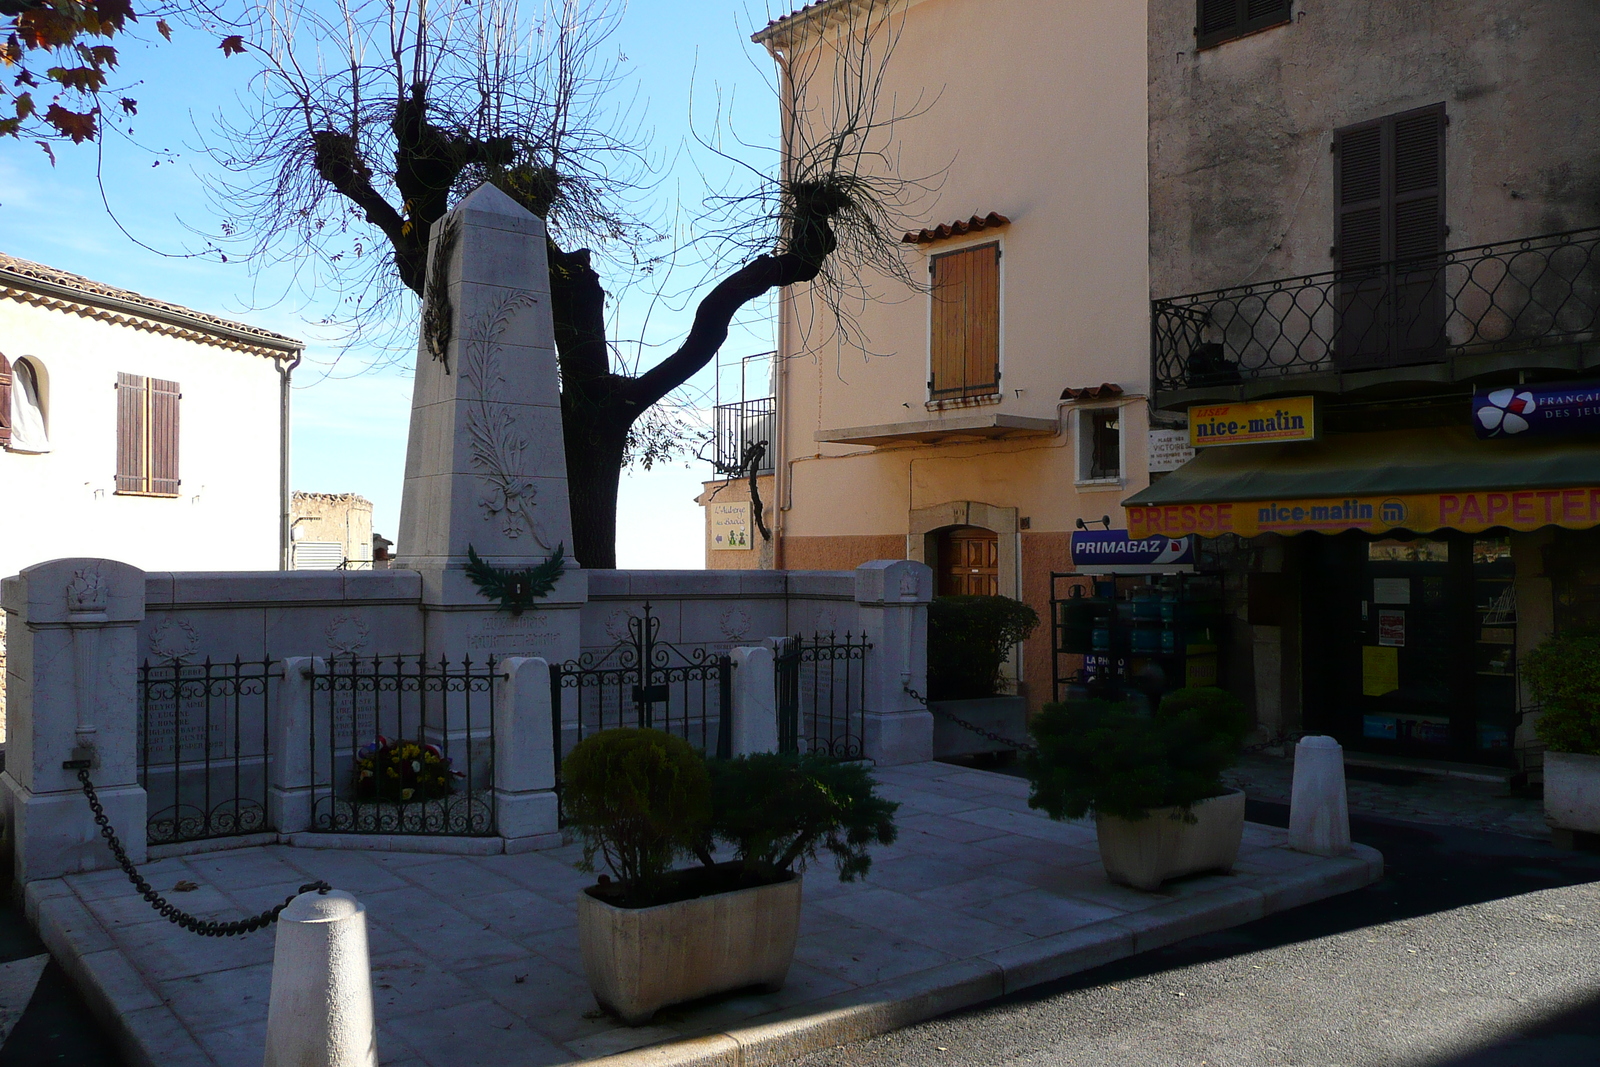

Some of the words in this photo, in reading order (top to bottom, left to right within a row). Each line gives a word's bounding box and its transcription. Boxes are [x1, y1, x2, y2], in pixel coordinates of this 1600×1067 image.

[1196, 407, 1230, 418] LISEZ
[1545, 410, 1570, 420] DES
[1196, 409, 1305, 437] nice-matin
[1130, 504, 1233, 533] PRESSE
[1258, 500, 1373, 522] nice-matin
[1076, 541, 1161, 554] PRIMAGAZ
[1087, 656, 1096, 664] LA
